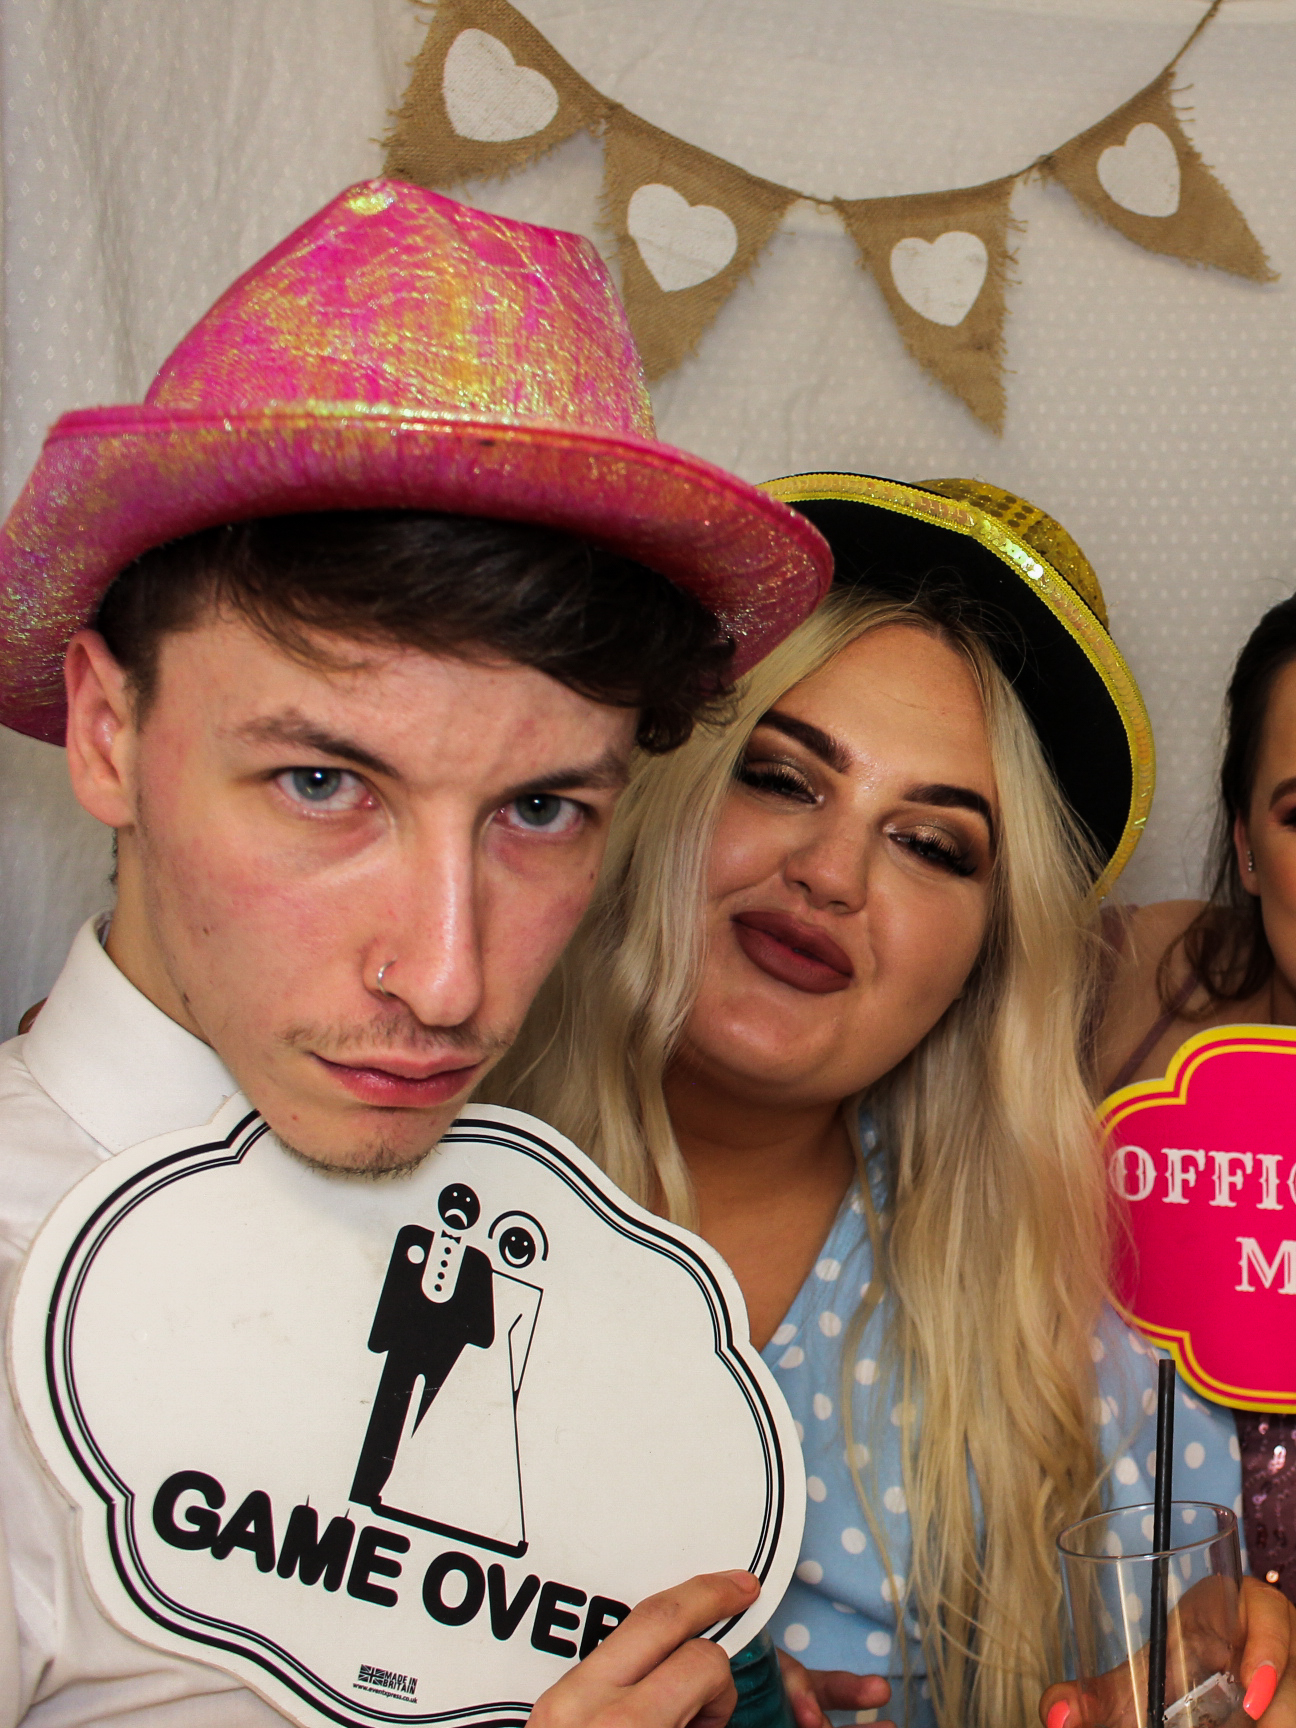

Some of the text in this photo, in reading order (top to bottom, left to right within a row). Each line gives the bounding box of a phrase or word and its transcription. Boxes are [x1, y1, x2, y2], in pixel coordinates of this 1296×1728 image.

[152, 1469, 411, 1608] GAME
[382, 1679, 417, 1695] BRITAIN
[383, 1670, 418, 1687] MADE IN
[352, 1682, 418, 1704] www.eventxpress.co.uk
